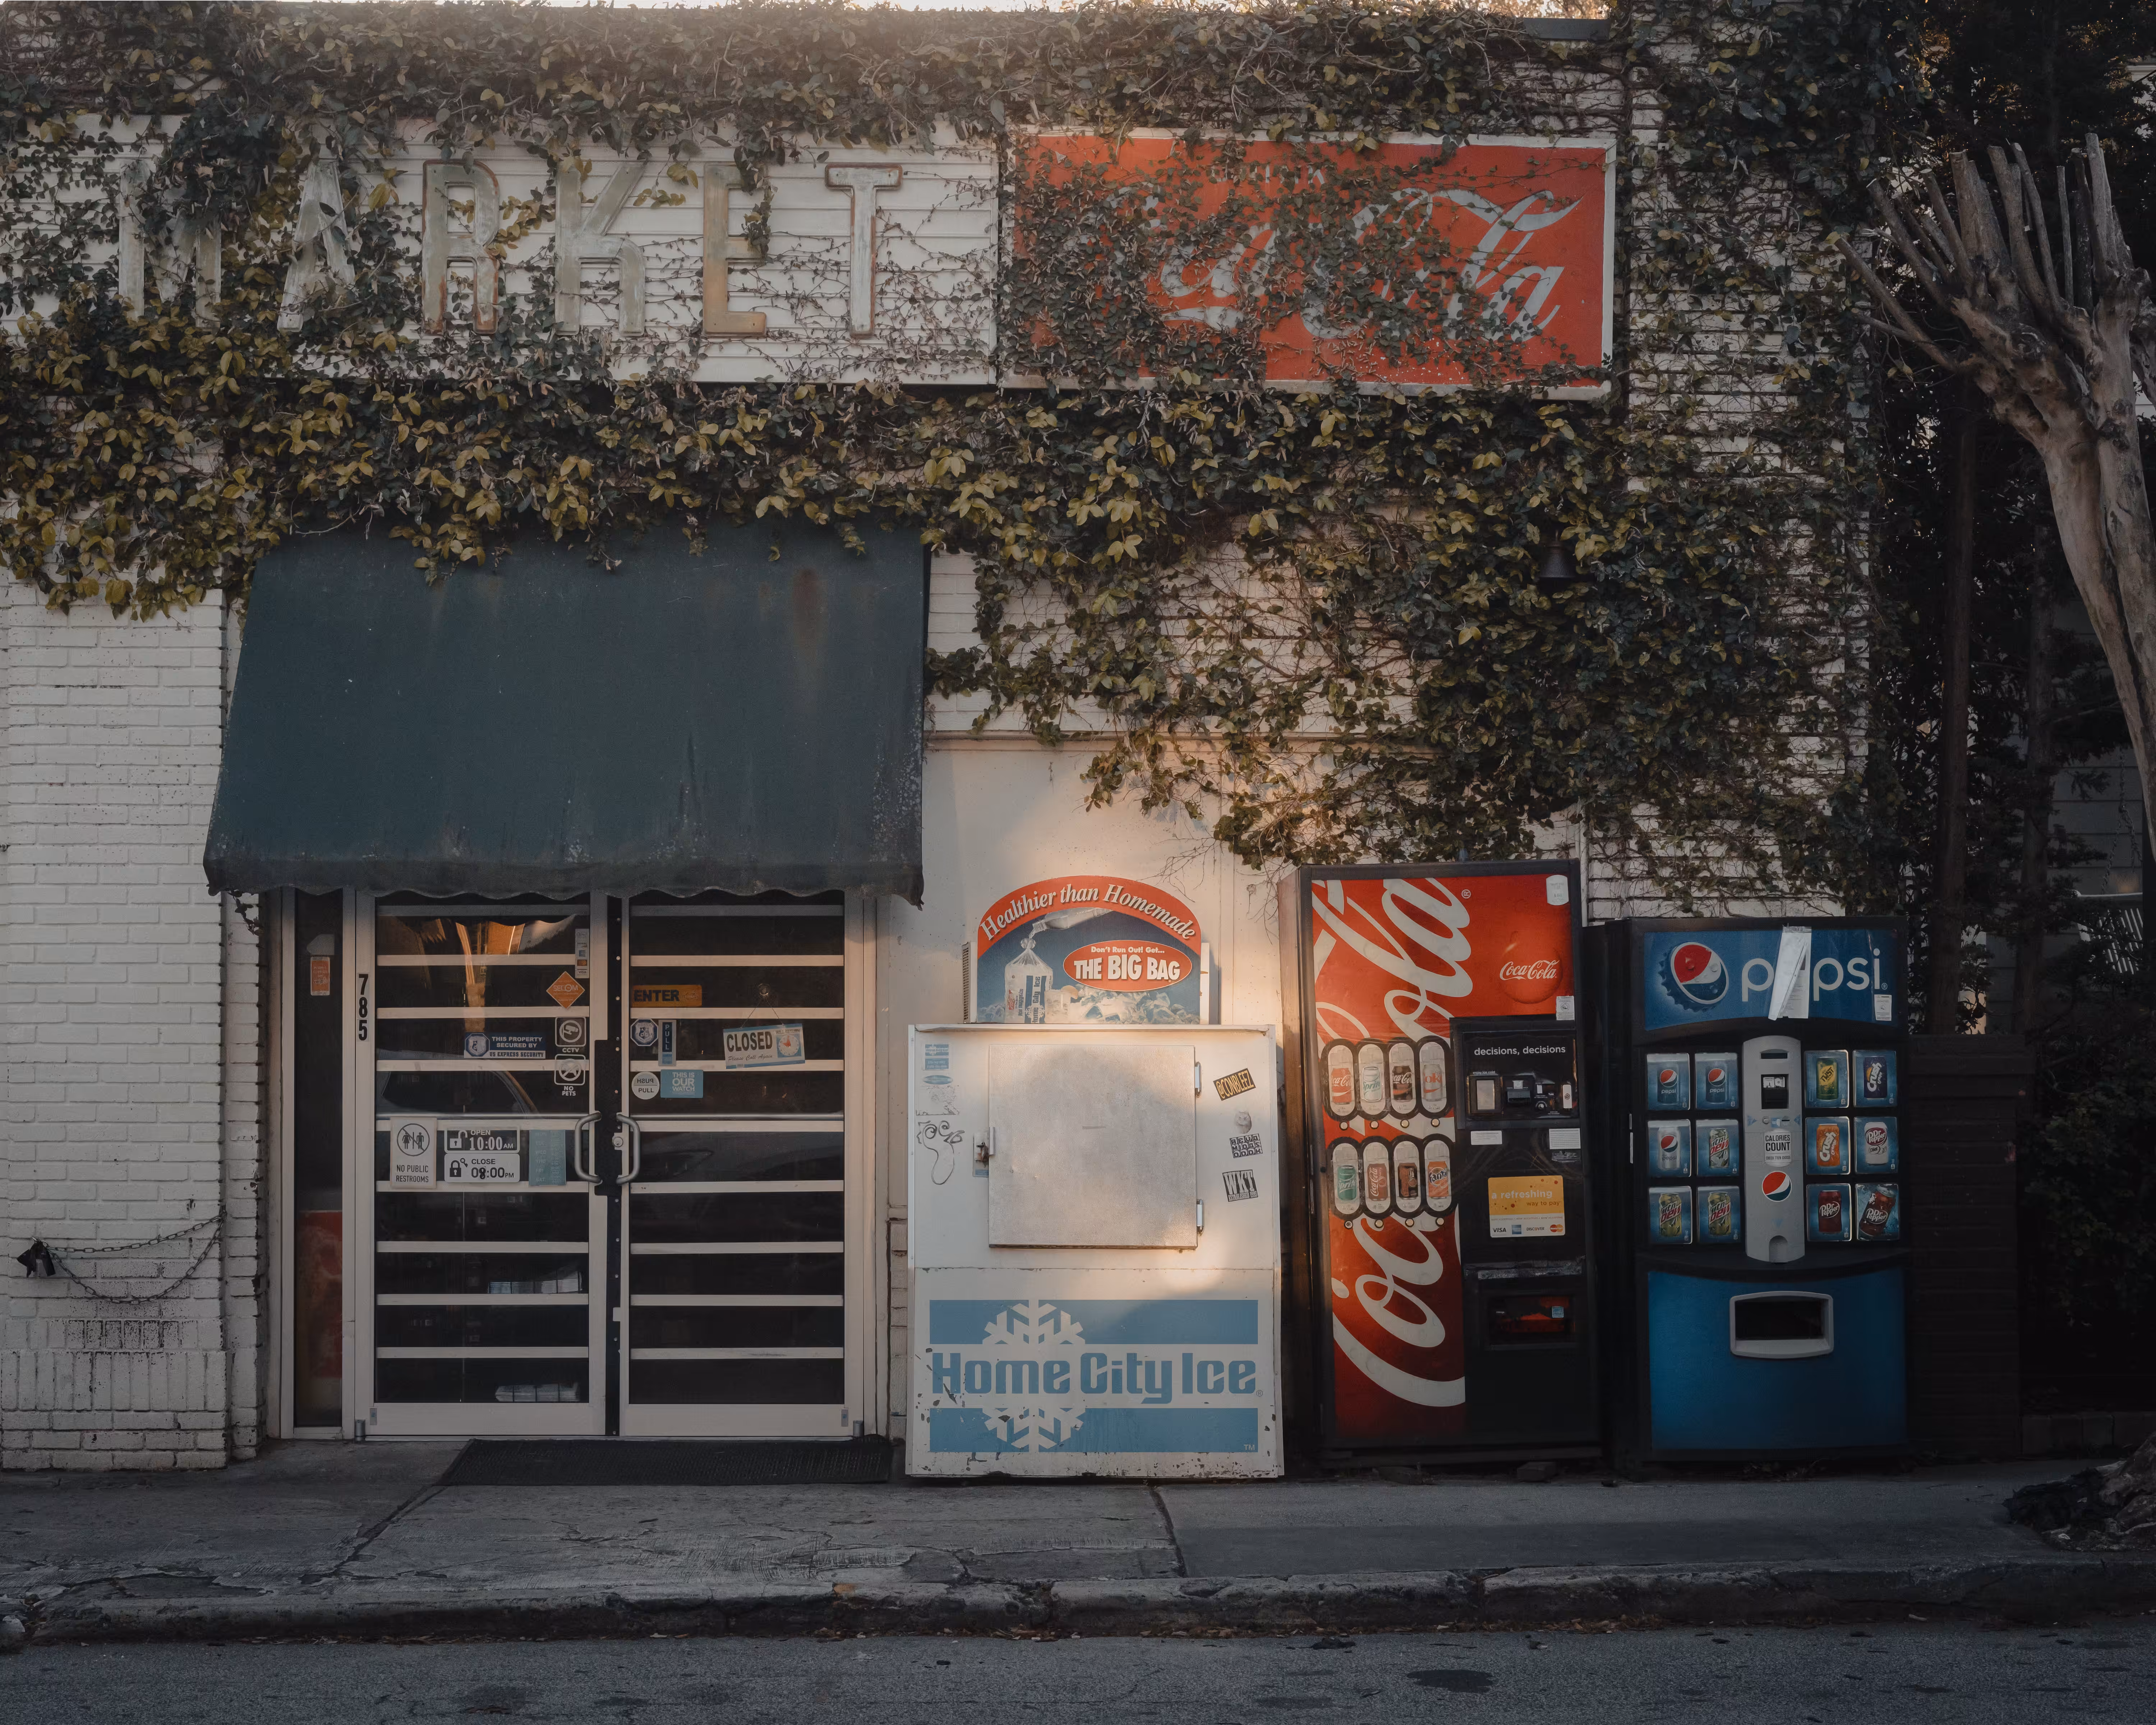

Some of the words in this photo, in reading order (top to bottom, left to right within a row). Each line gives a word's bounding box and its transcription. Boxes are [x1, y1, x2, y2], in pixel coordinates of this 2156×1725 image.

[981, 891, 1056, 940] Healthier
[1060, 884, 1098, 903] than
[1102, 884, 1195, 939] Homemade
[1074, 957, 1102, 980] THE
[1108, 954, 1142, 980] BIG
[1147, 957, 1180, 981] BAG
[1500, 960, 1560, 981] Coca-Cola
[1742, 948, 1880, 1002] ppsi
[633, 989, 679, 1002] ENTER
[359, 974, 368, 1041] 785
[727, 1031, 773, 1052] CLOSED
[1474, 1047, 1520, 1055] decisions,
[1522, 1046, 1566, 1054] decisions
[1216, 1070, 1254, 1099] @CONBLEEZ
[1867, 1062, 1883, 1092] Crush
[469, 1136, 503, 1150] 10:00
[1766, 1142, 1791, 1151] COUNT
[1820, 1132, 1837, 1162] Crush
[1868, 1131, 1886, 1144] Pepper
[1222, 1171, 1254, 1195] WKT
[1501, 1190, 1552, 1199] refreshing
[1820, 1205, 1839, 1217] Pepper
[1826, 1203, 1835, 1211] Dr
[1866, 1209, 1887, 1222] Pepper
[932, 1353, 1070, 1394] Home
[1080, 1352, 1173, 1404] City
[1182, 1353, 1256, 1394] Ice
